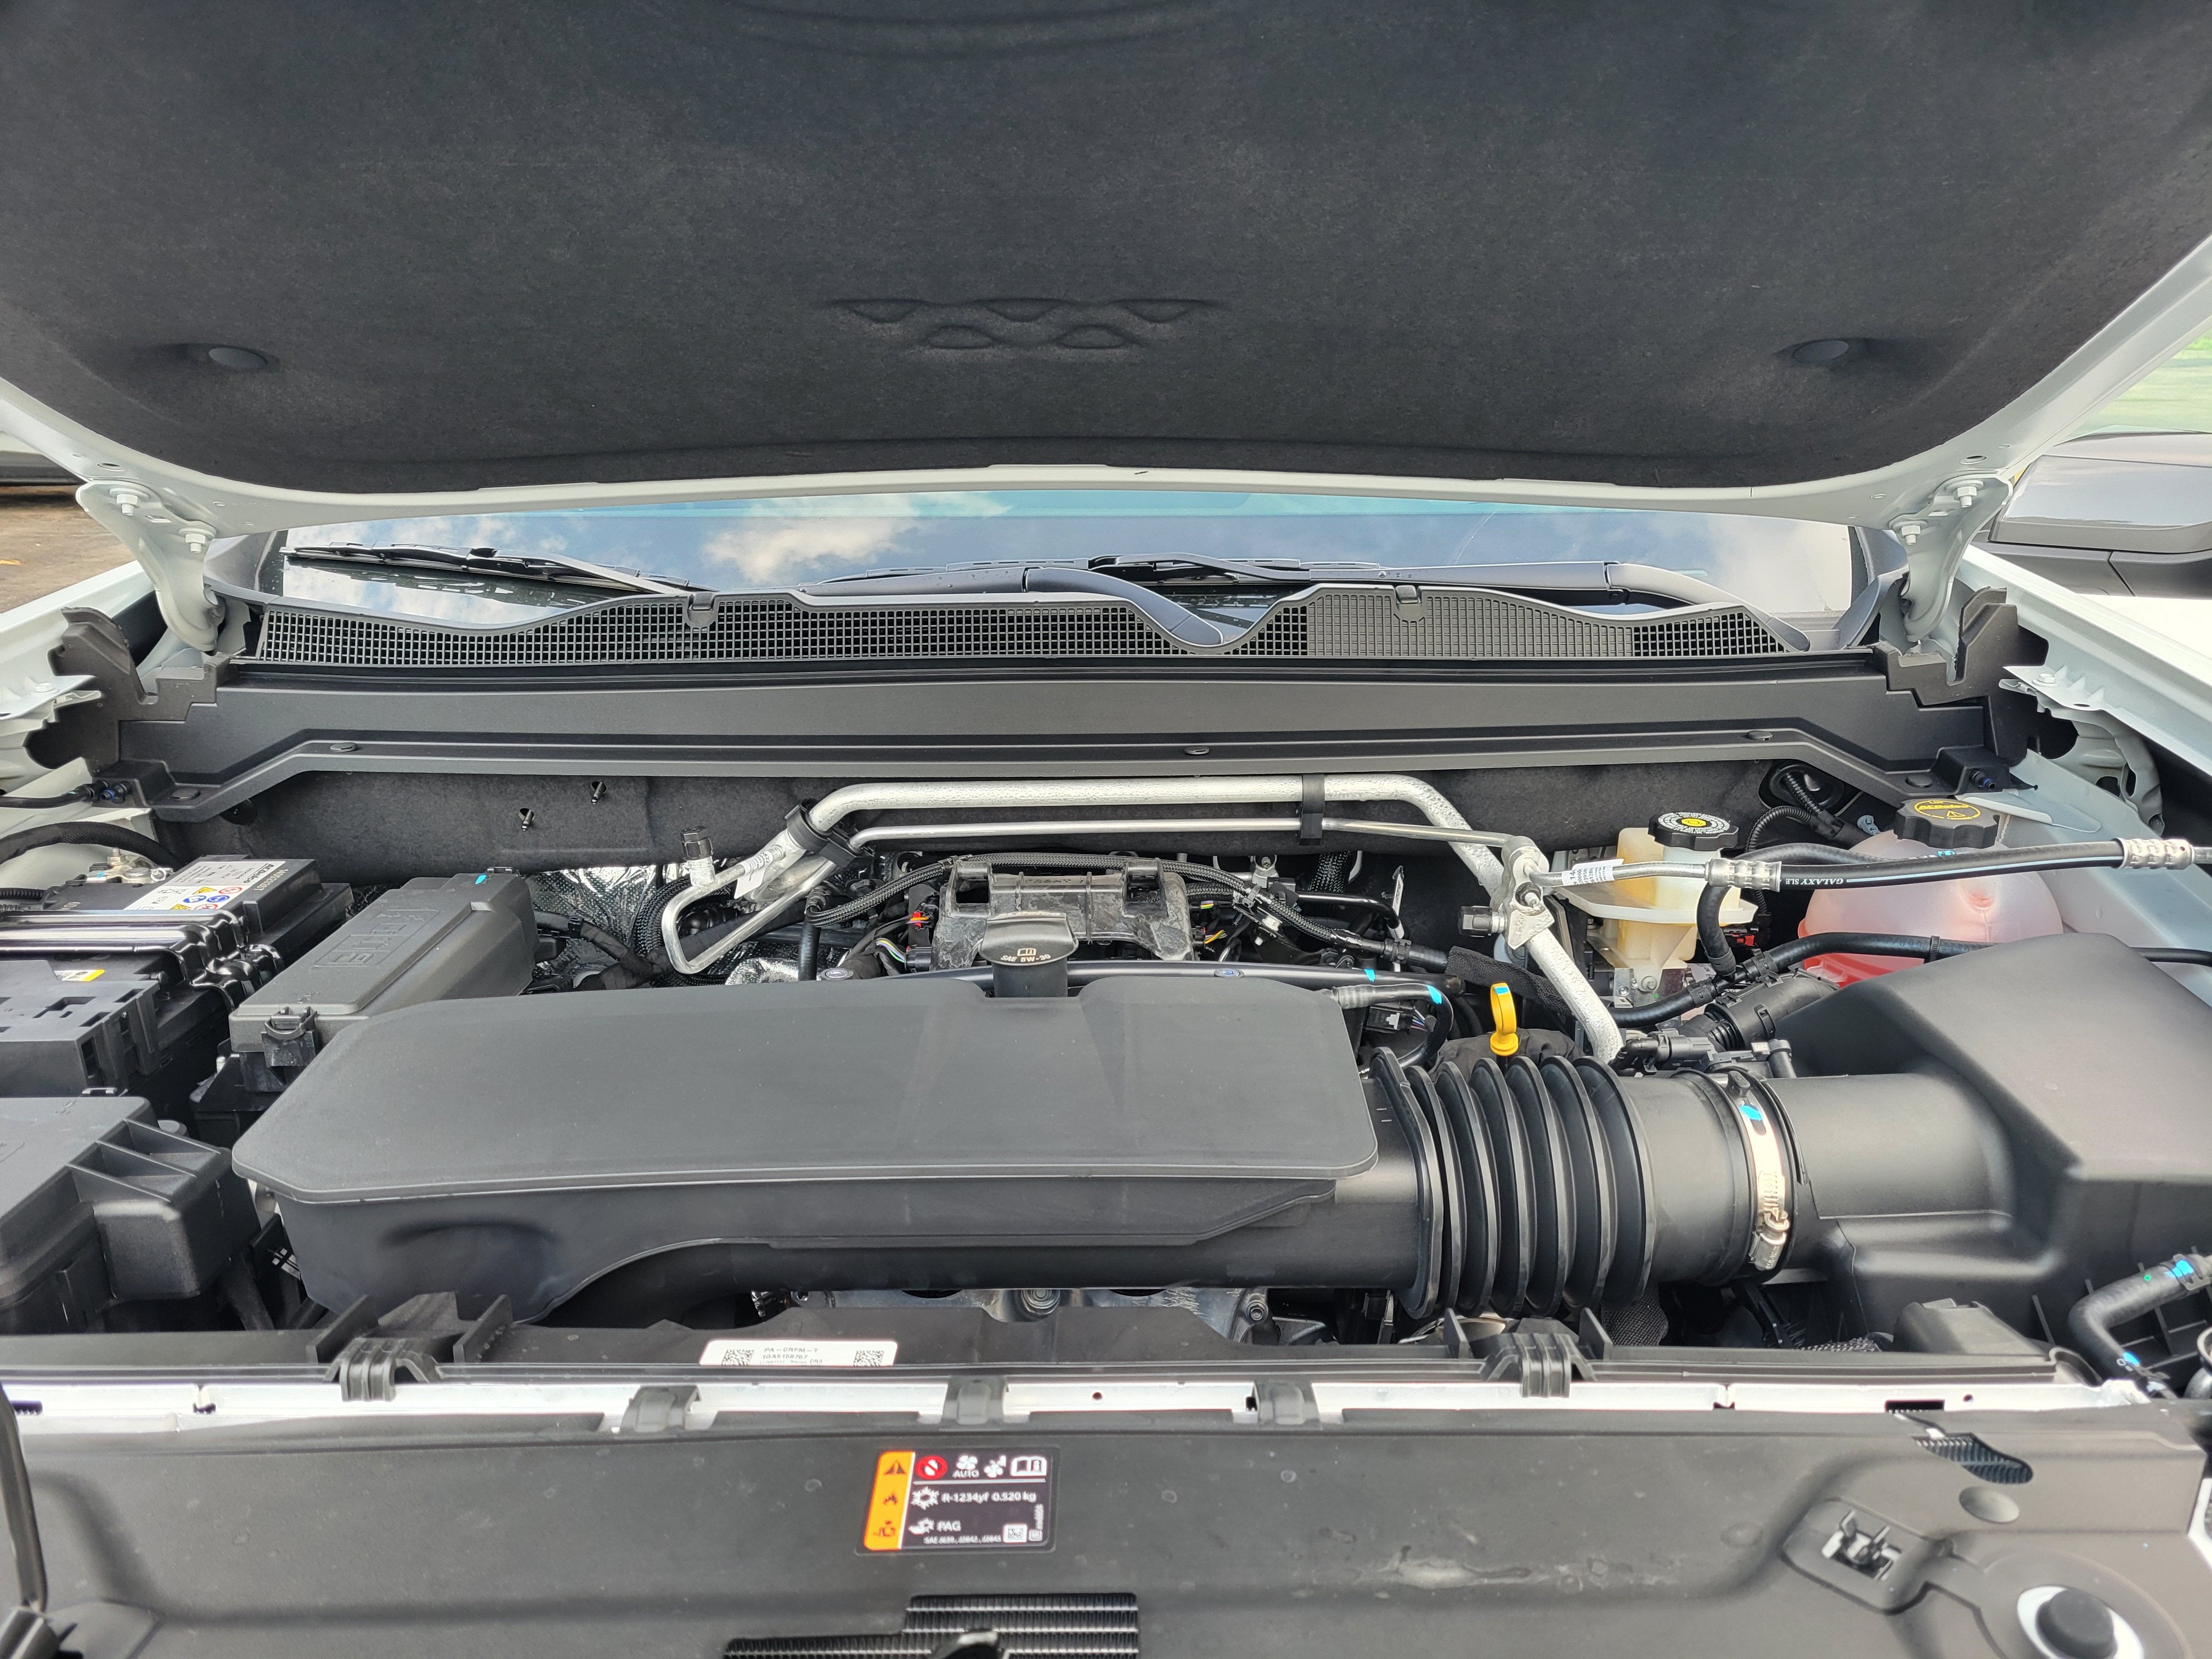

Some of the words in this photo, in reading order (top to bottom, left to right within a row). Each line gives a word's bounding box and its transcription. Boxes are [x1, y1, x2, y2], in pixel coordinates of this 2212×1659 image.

[244, 864, 274, 882] ACDelco
[1020, 953, 1052, 962] 5W-30
[952, 1470, 979, 1479] AUTO
[941, 1492, 989, 1504] R-1234yf
[991, 1492, 1022, 1502] 0.520
[1022, 1491, 1037, 1503] kg
[936, 1520, 962, 1532] PAG
